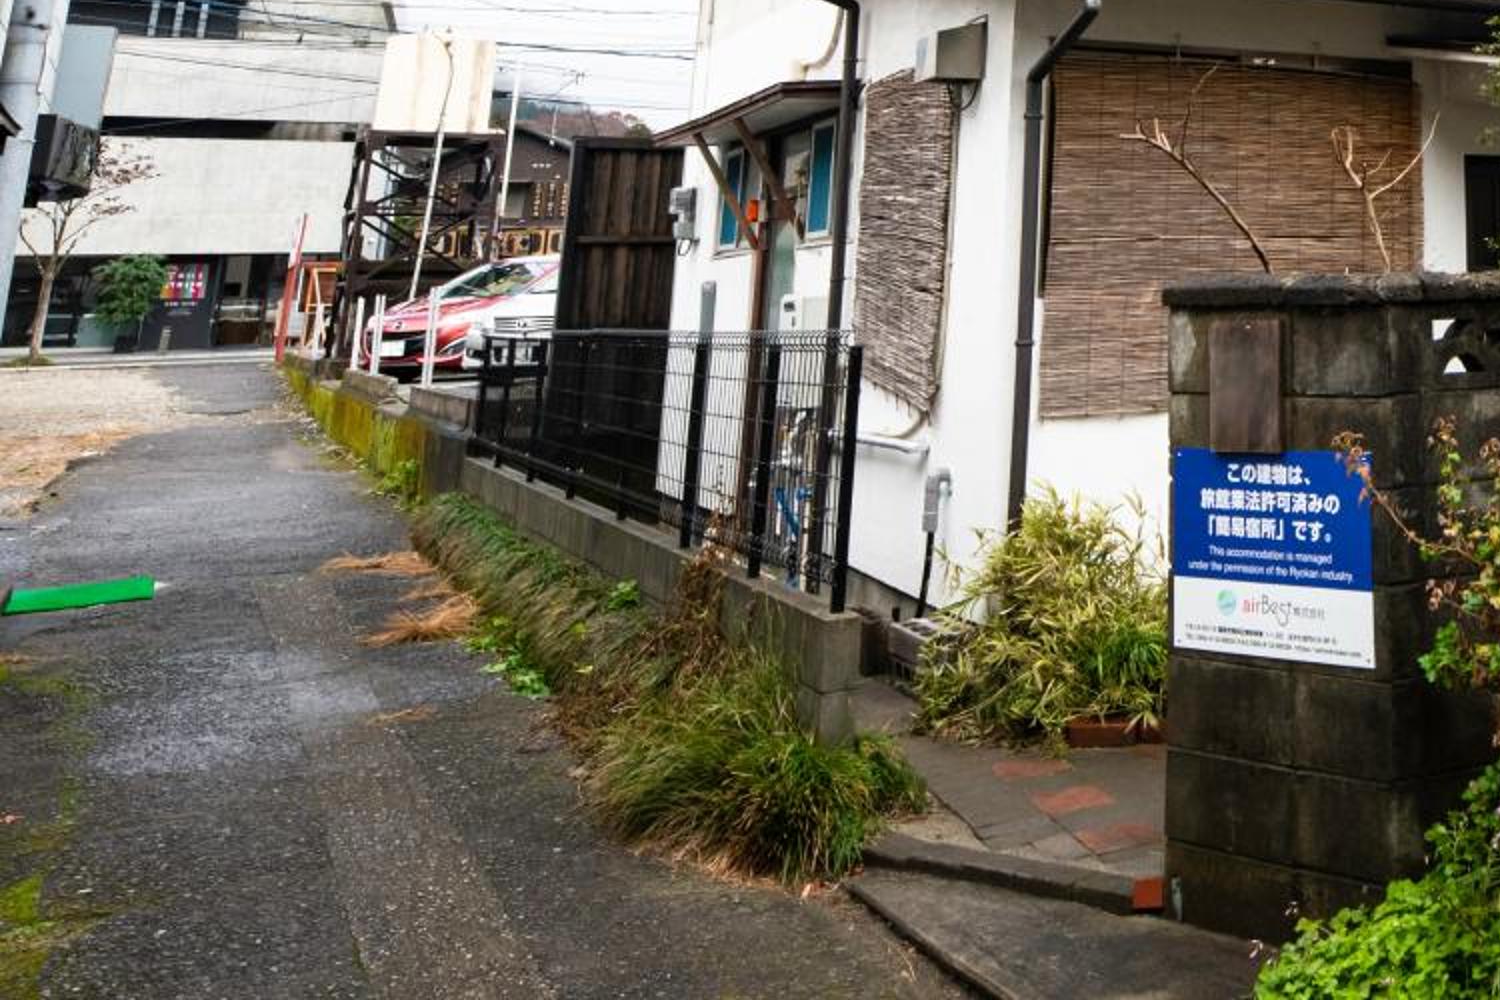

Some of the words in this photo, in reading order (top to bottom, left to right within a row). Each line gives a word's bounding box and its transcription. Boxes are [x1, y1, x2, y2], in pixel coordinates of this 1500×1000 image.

[1227, 463, 1311, 485] この建物は、
[1200, 488, 1340, 514] 旅館業法許可済みの
[1208, 545, 1225, 557] This
[1226, 547, 1285, 561] accommodation
[1286, 552, 1294, 562] is
[1296, 553, 1333, 566] managed
[1188, 559, 1209, 570] under
[1211, 560, 1223, 571] the
[1224, 562, 1264, 575] permission
[1265, 564, 1275, 575] of
